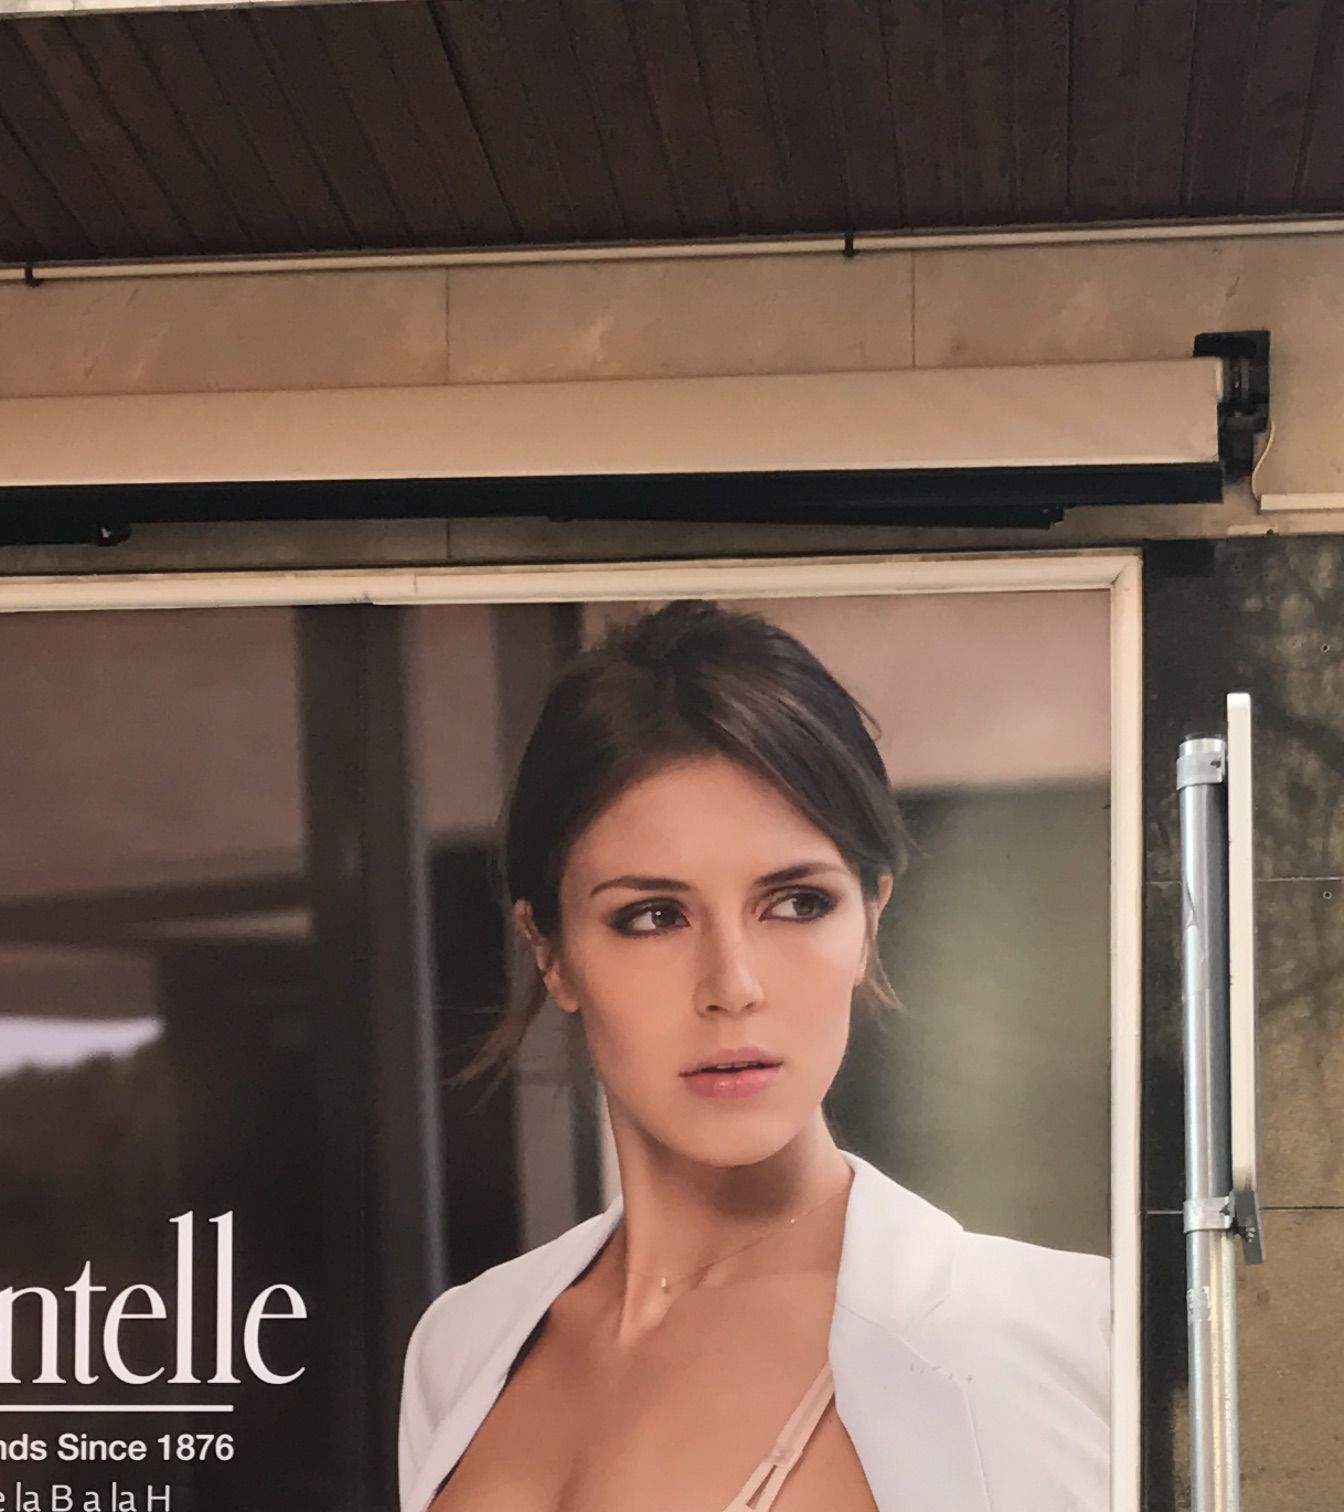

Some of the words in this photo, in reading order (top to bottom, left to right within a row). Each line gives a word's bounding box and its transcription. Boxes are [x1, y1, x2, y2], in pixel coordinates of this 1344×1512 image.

[57, 1434, 147, 1461] Since
[158, 1434, 234, 1461] 1876
[16, 1483, 41, 1512] la
[52, 1485, 73, 1512] B
[83, 1492, 101, 1512] a
[111, 1483, 136, 1512] la
[147, 1485, 171, 1512] H
